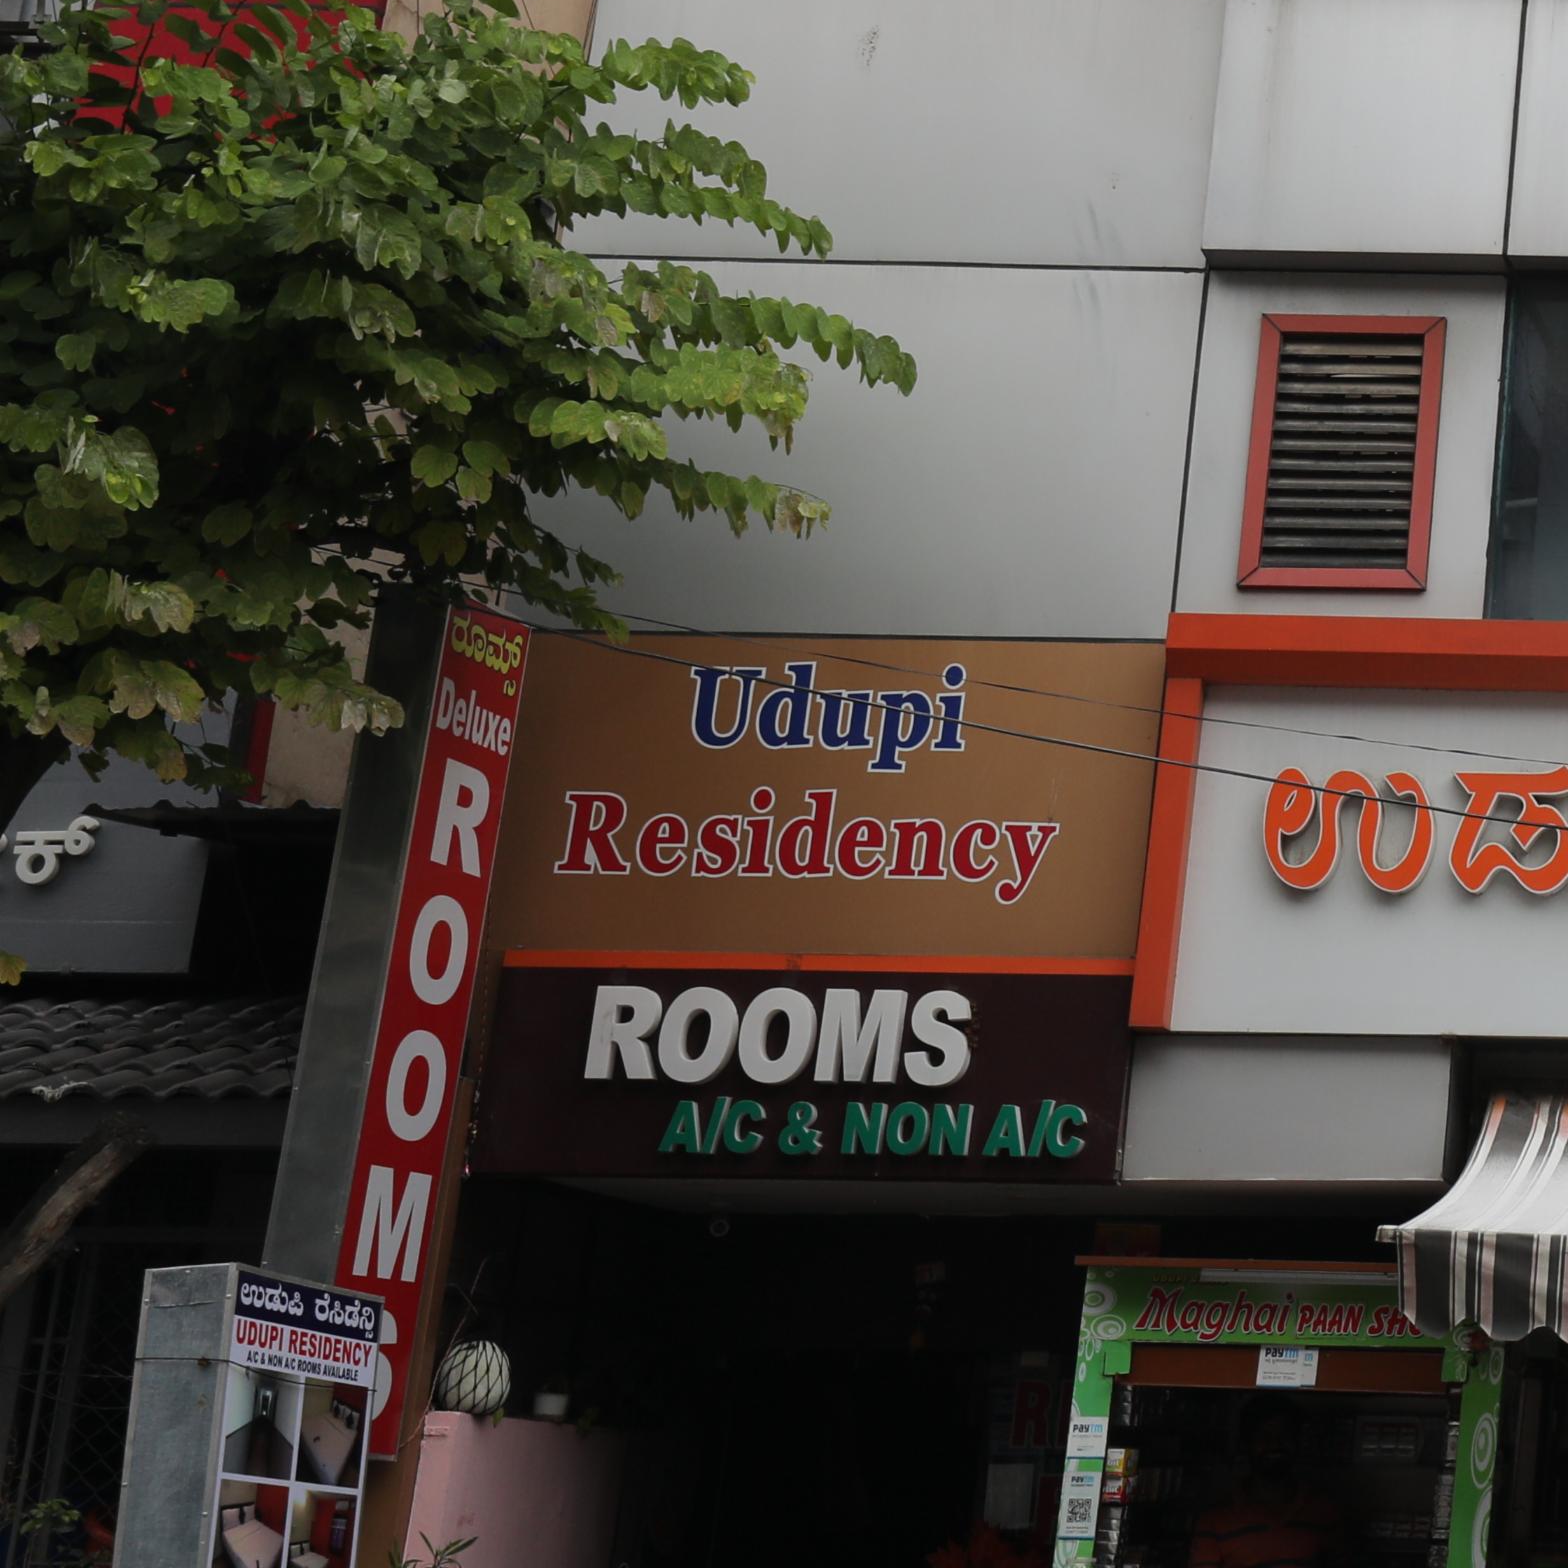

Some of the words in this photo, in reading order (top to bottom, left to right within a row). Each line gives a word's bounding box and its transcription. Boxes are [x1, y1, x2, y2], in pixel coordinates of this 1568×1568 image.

[435, 676, 512, 756] Deluxe
[690, 659, 969, 773] Udupi
[553, 786, 1060, 906] Residency
[584, 984, 973, 1087] ROOMS
[658, 1095, 768, 1156] A/C
[778, 1100, 824, 1157] &
[841, 1102, 974, 1158] NON
[981, 1097, 1089, 1159] A/C
[240, 1282, 304, 1317] ಉಡುಪಿ
[1132, 1286, 1297, 1341] Maghai
[1296, 1303, 1364, 1336] PAAN
[235, 1318, 284, 1352] UDUPI
[287, 1329, 373, 1368] RESIDENCY
[268, 1354, 283, 1368] NON
[297, 1360, 322, 1376] ROOMS
[322, 1365, 359, 1382] AVAILABLE
